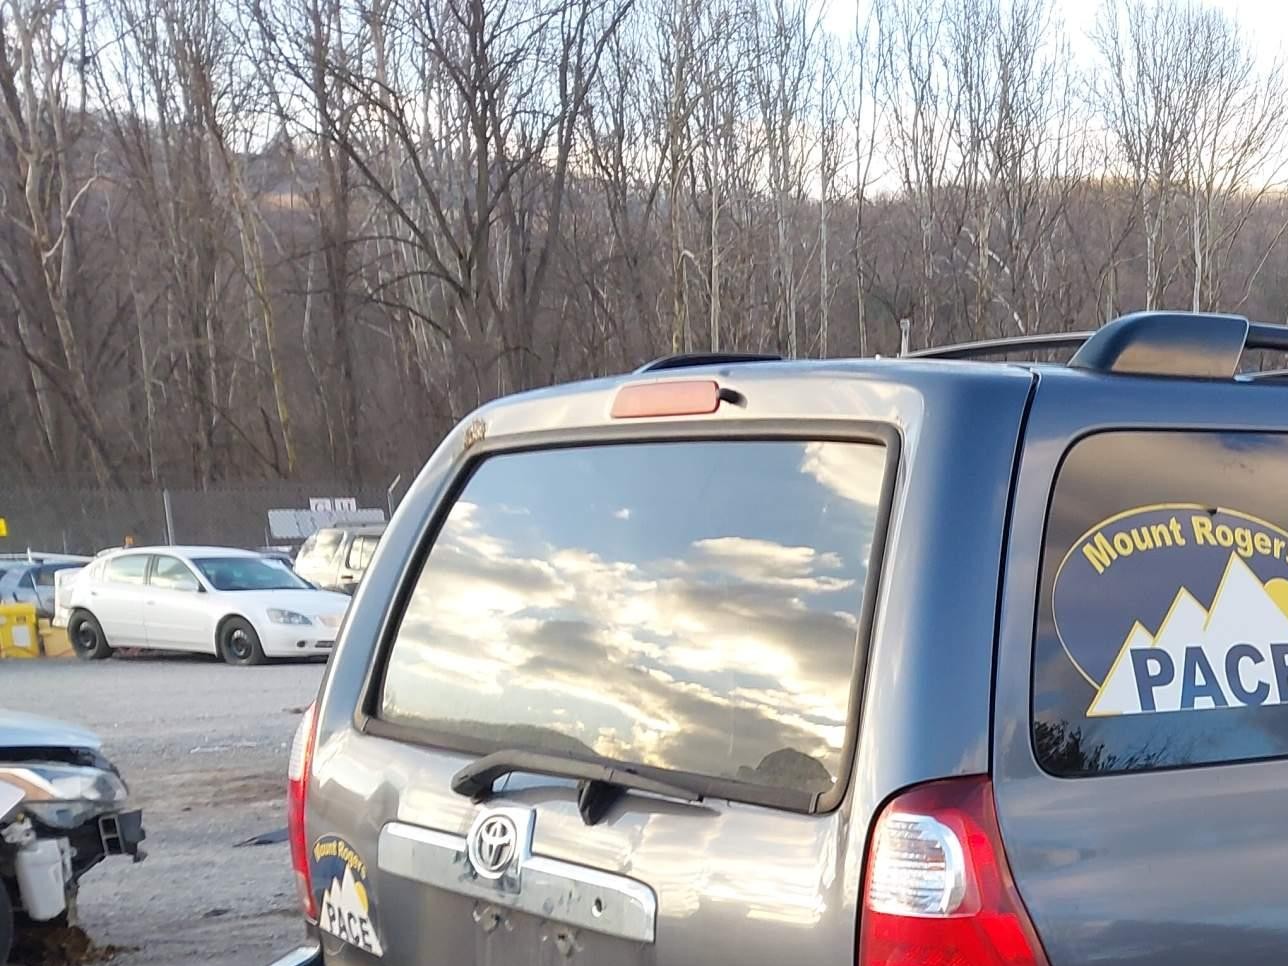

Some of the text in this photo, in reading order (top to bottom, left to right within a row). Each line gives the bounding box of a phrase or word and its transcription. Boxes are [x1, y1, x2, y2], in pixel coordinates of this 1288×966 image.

[1082, 516, 1186, 574] Mount
[313, 840, 367, 880] Mount Rogers
[327, 902, 373, 952] PACE
